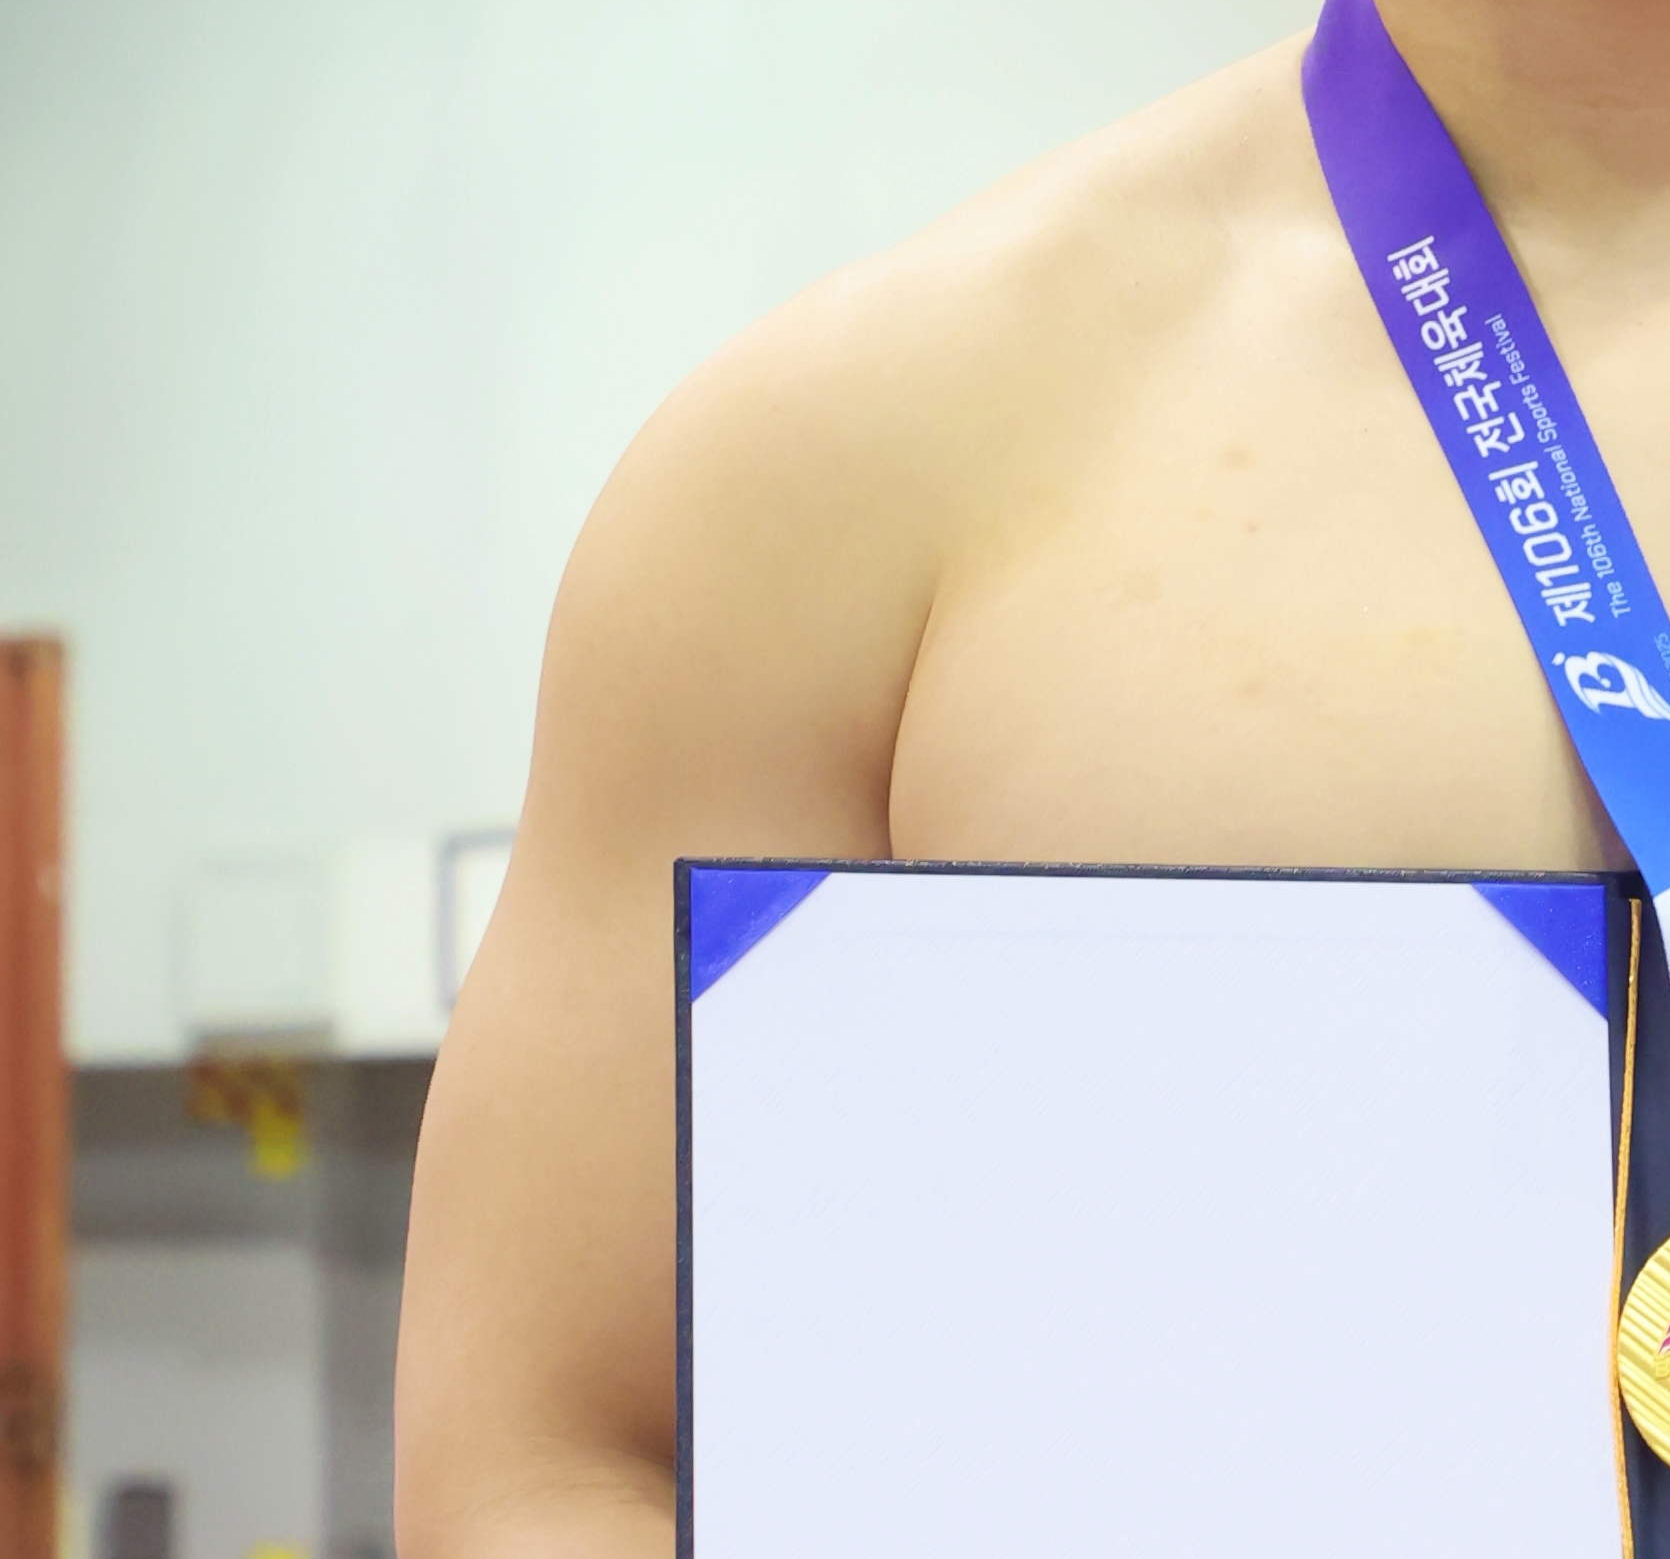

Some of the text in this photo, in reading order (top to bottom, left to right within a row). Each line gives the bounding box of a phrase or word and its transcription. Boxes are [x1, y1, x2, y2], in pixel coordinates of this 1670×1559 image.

[1387, 235, 1596, 627] 제106회 전국체육대회
[1485, 312, 1631, 619] The 106th National Sports Festival
